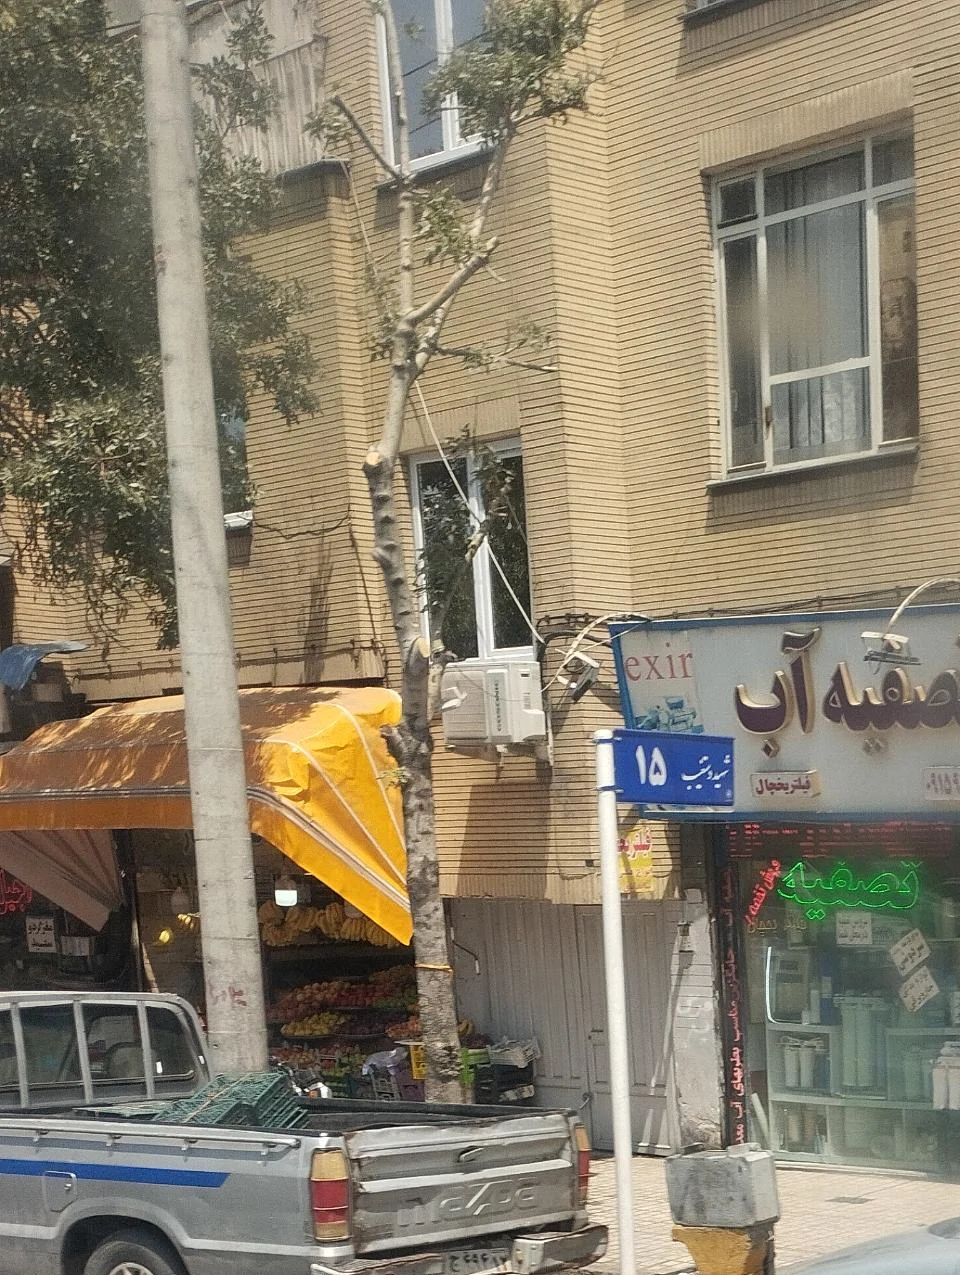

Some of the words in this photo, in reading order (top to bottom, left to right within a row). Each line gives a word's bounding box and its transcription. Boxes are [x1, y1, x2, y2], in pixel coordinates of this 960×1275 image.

[624, 642, 694, 682] exir
[734, 627, 821, 759] آب
[635, 745, 667, 786] ۱۵
[755, 776, 790, 795] یخچال
[790, 774, 811, 794] فیلتر
[777, 859, 924, 920] تصفیه
